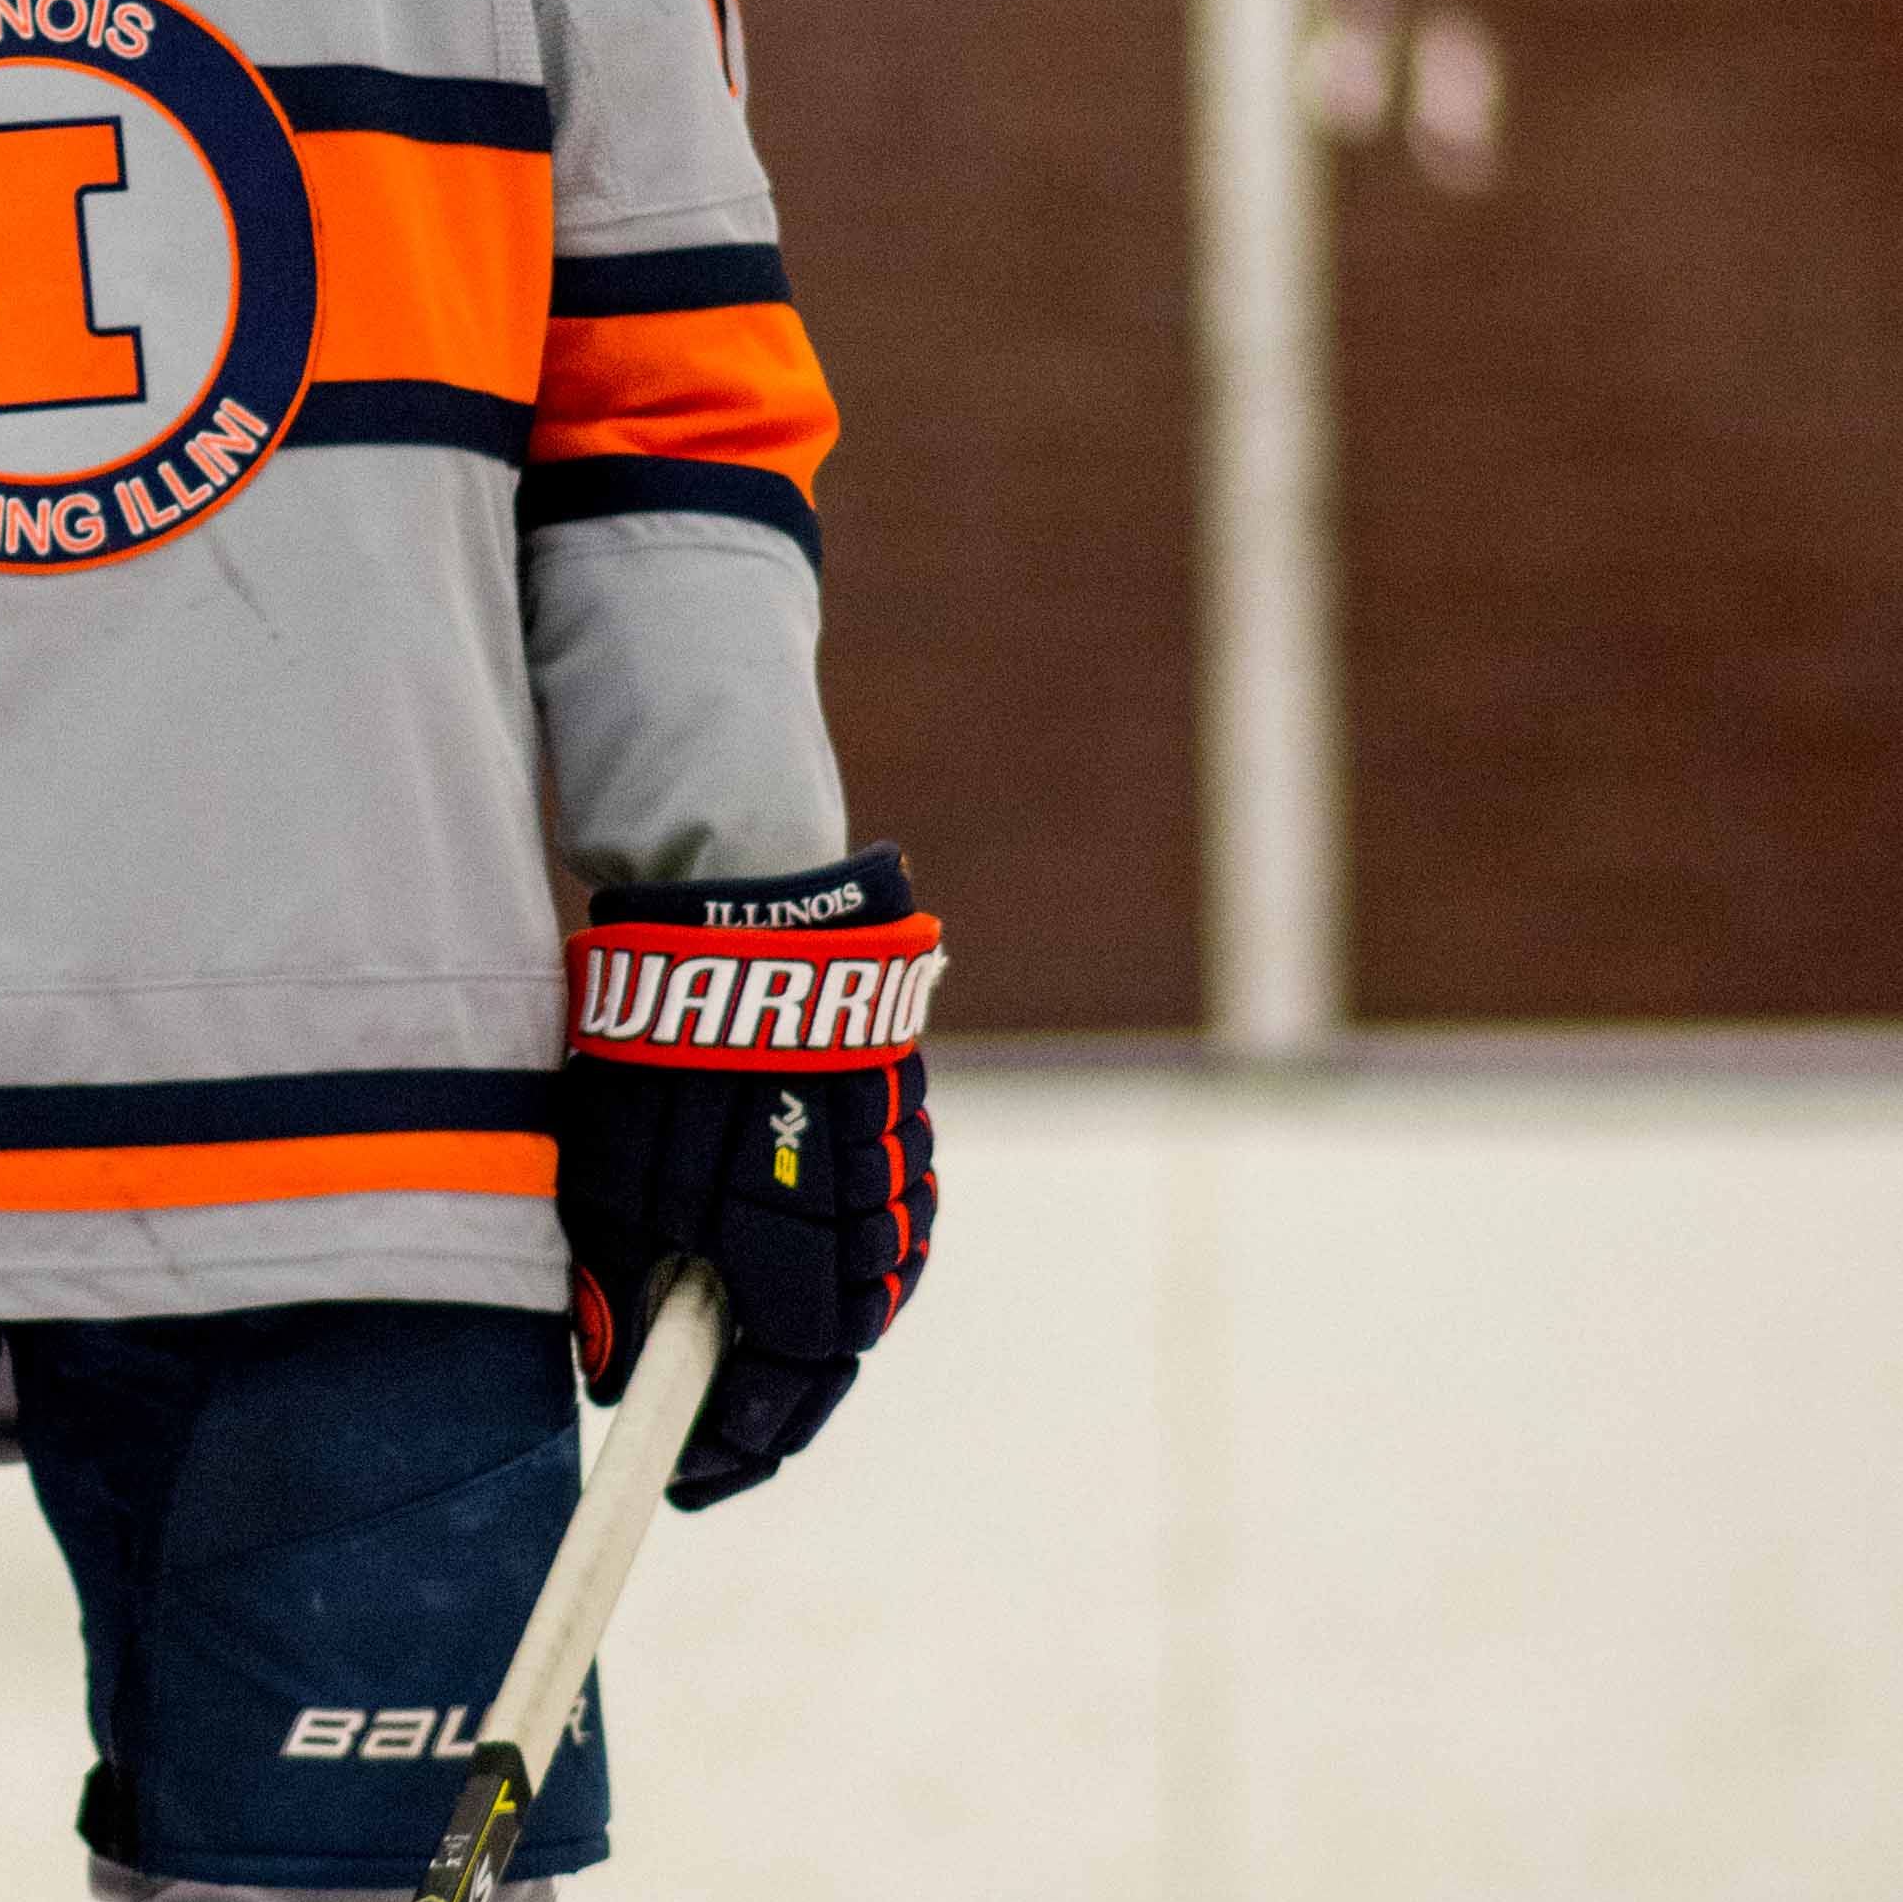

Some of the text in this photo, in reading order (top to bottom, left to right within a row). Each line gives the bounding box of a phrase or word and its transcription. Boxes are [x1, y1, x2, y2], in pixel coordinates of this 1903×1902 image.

[113, 398, 270, 536] ILLINI
[703, 881, 864, 929] ILLINOIS
[580, 944, 947, 1049] WARRIO
[280, 1696, 593, 1759] BAUR
